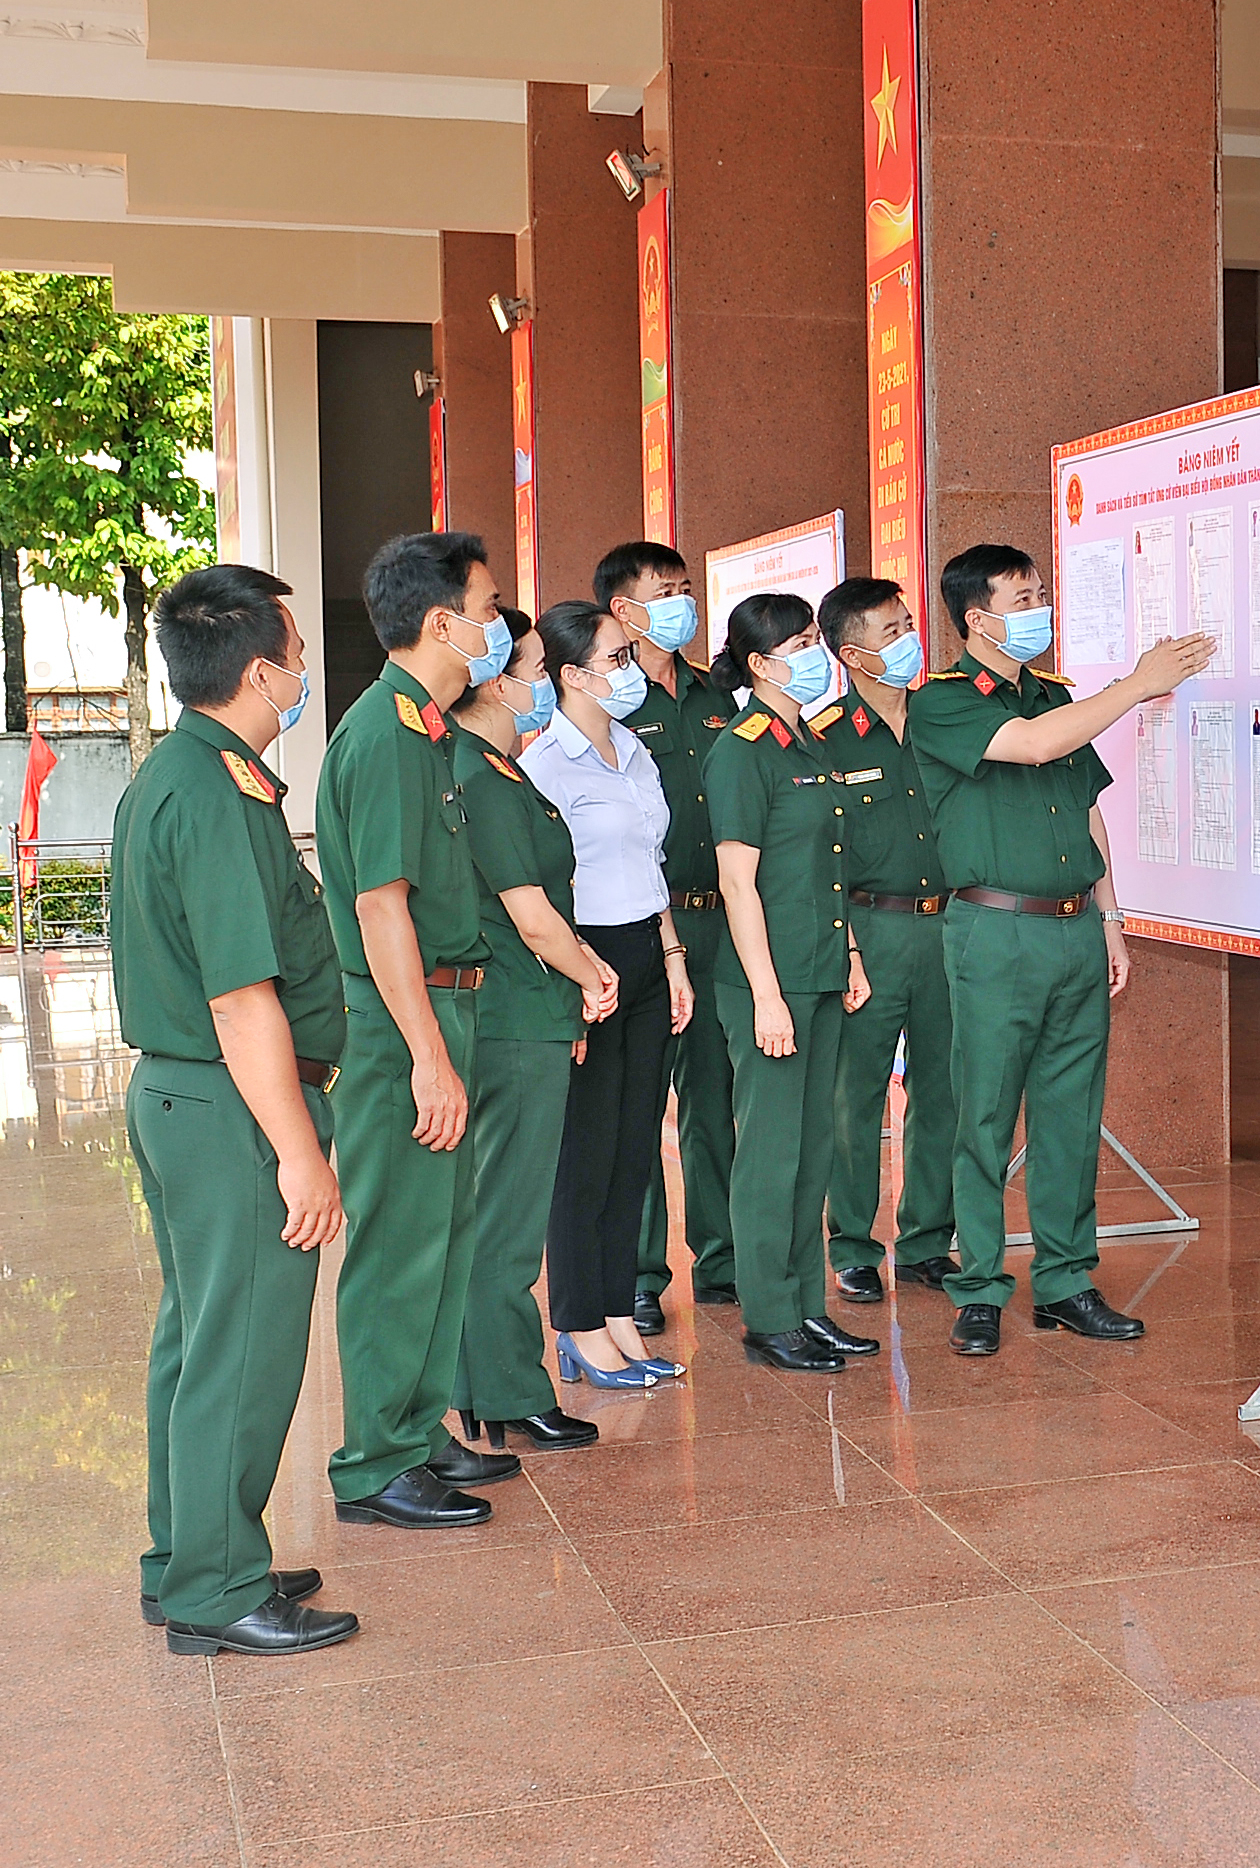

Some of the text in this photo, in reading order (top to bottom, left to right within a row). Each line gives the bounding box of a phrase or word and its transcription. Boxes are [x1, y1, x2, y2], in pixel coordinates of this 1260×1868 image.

[1178, 436, 1240, 474] BẢNG NIÊM YẾT
